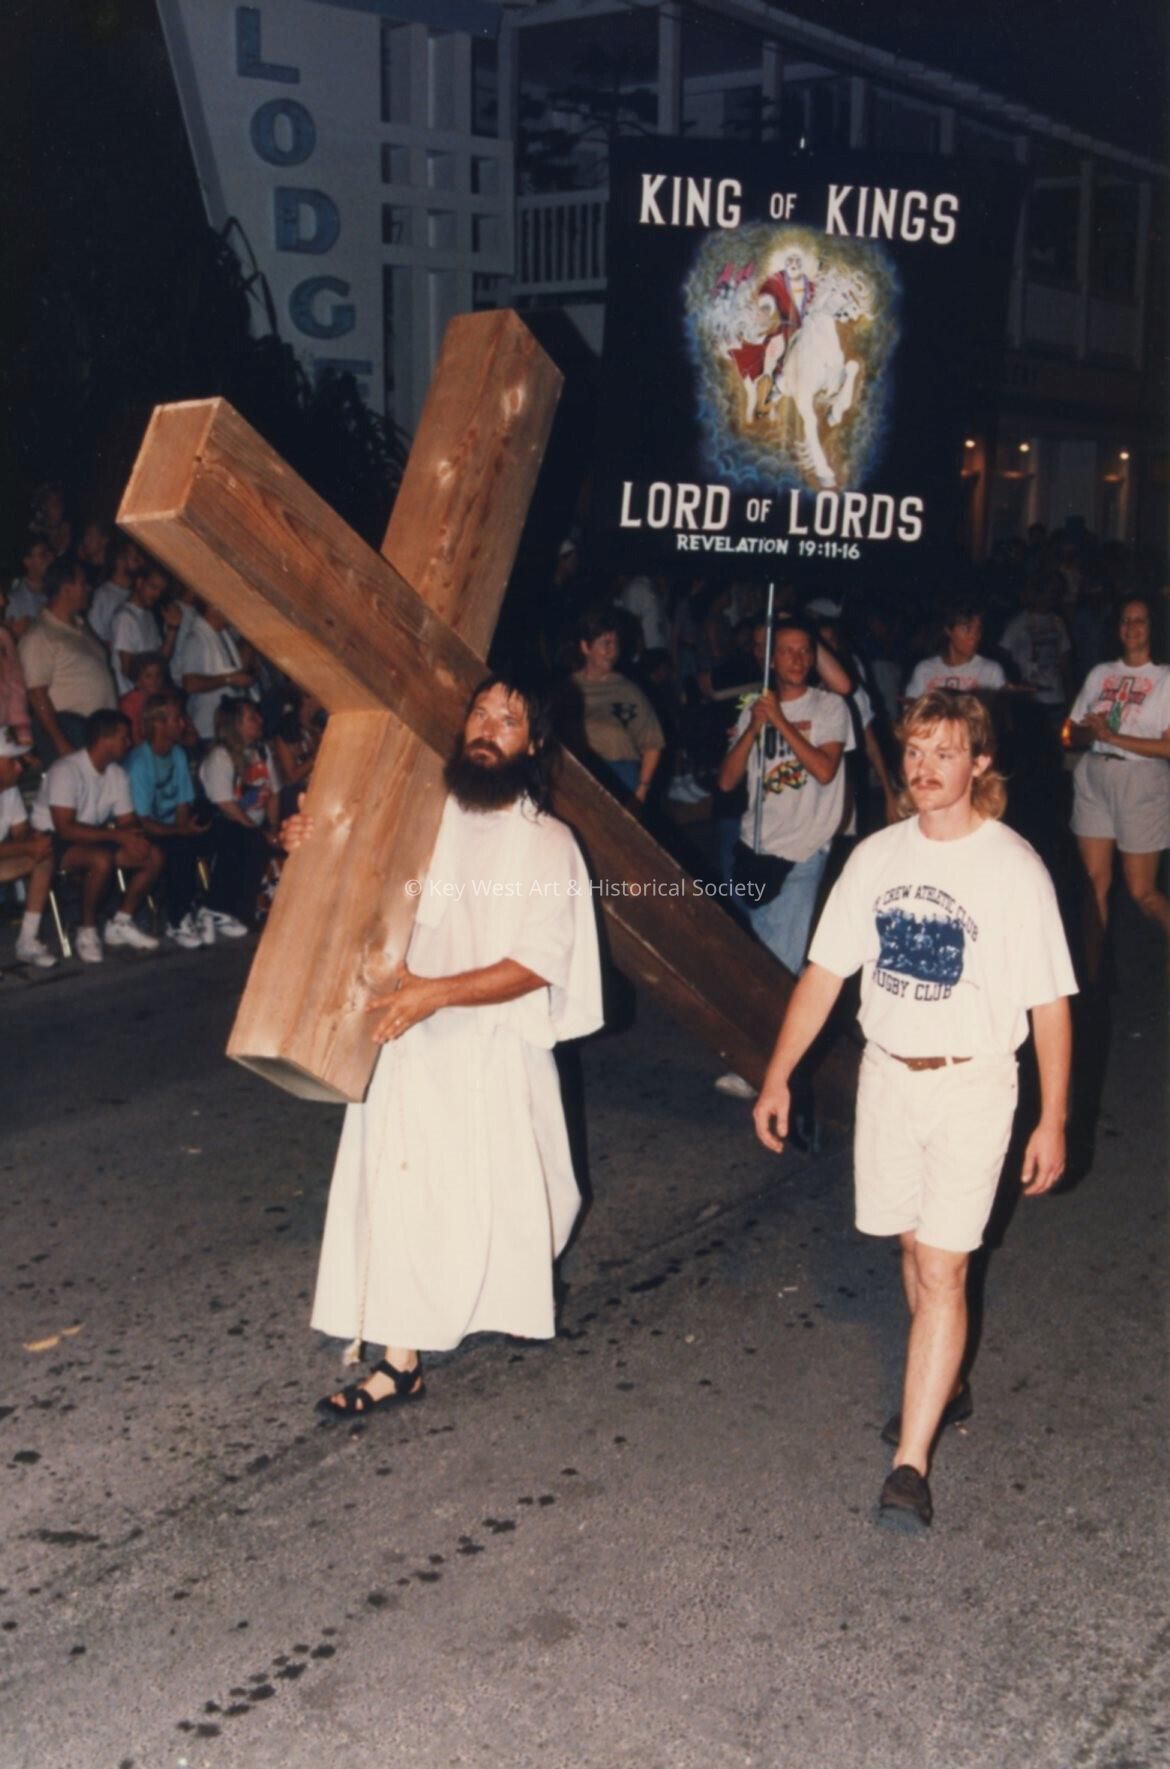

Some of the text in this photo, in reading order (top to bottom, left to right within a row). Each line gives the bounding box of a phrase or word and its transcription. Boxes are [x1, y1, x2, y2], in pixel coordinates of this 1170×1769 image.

[639, 174, 959, 245] KING OF KINGS
[620, 481, 924, 541] LORD OF LORDS
[677, 534, 860, 560] REVELATION 19:11-16
[915, 983, 952, 1001] CLUB
